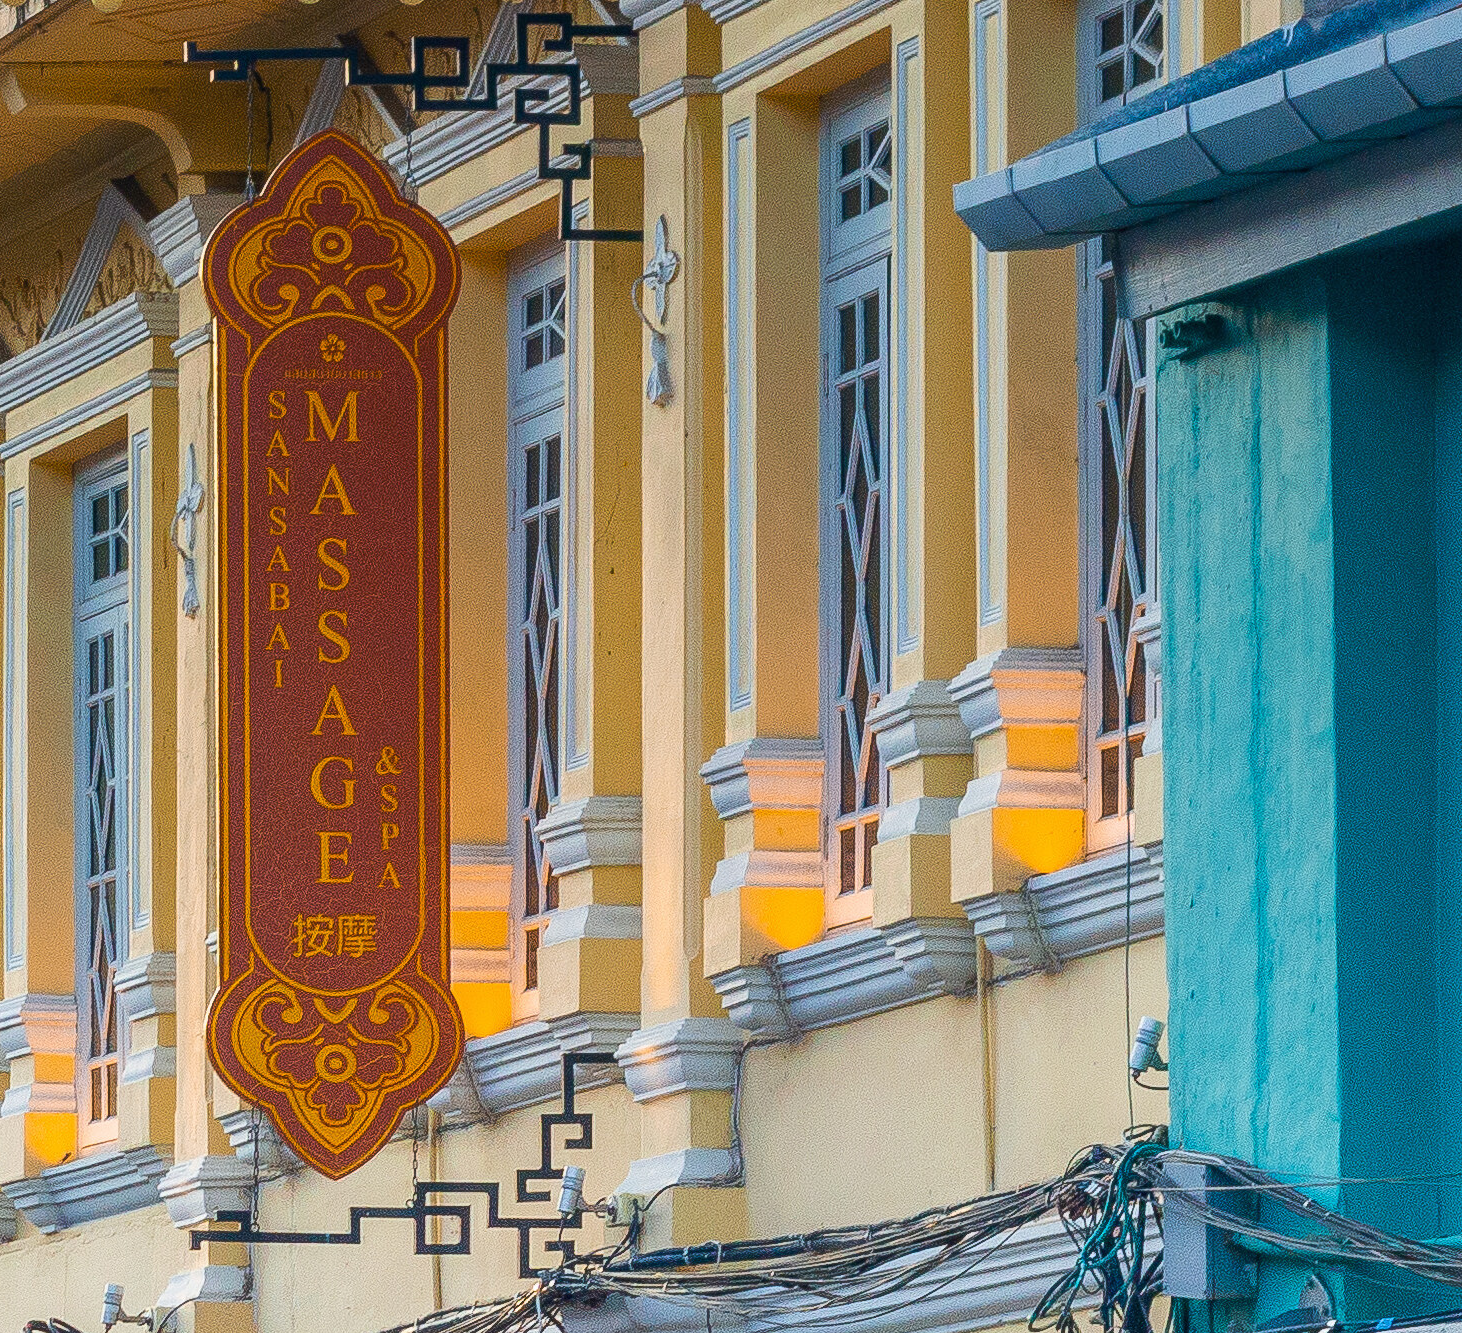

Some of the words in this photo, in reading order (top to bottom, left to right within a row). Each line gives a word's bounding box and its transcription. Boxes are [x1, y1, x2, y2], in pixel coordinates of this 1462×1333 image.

[264, 389, 294, 690] SANSABAI
[304, 388, 362, 887] MASSAGE
[291, 912, 379, 959] 按摩
[379, 783, 403, 890] SPA
